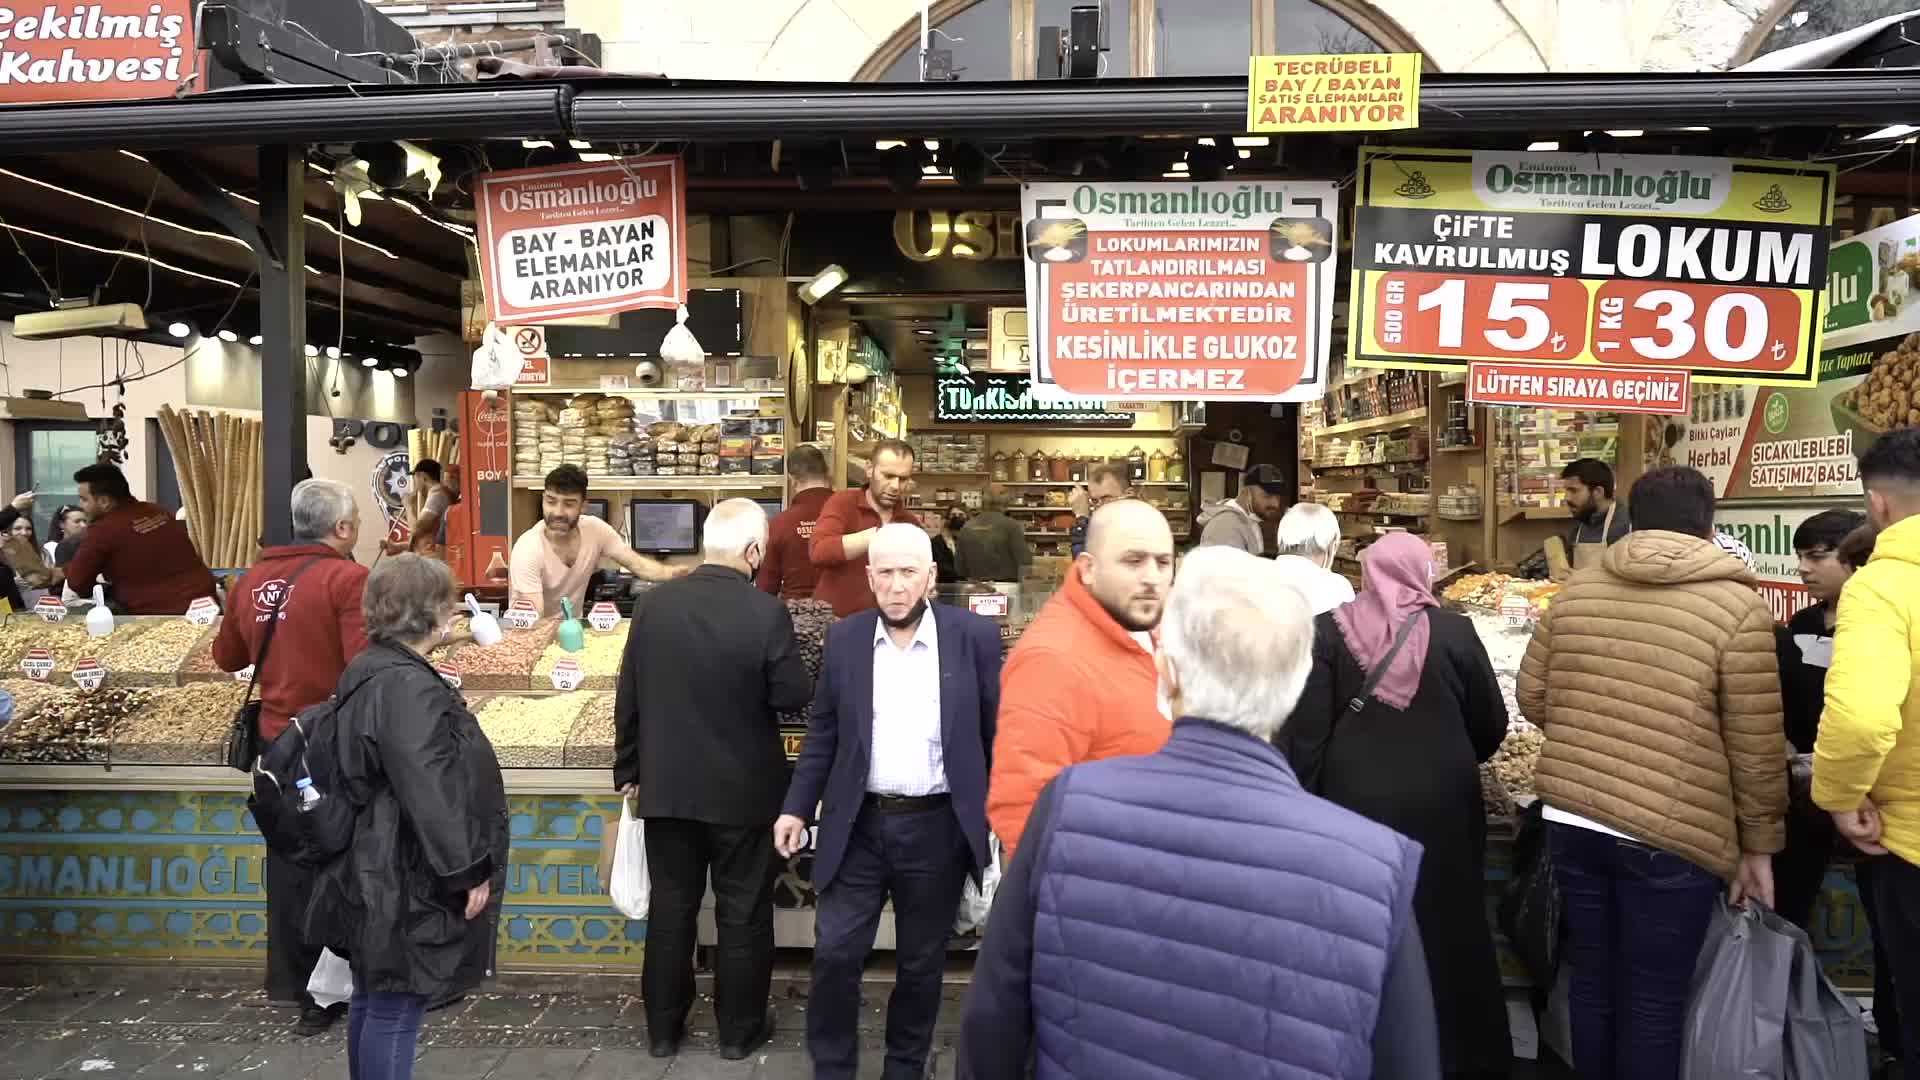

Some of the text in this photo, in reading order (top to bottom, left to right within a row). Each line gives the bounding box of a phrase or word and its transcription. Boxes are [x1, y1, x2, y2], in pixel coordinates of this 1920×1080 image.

[0, 48, 183, 84] Kahvesi
[1274, 56, 1392, 75] TECRÜBELİ
[1265, 77, 1400, 92] BAY / BAYAN
[1306, 92, 1403, 104] ELEMANLARI
[1258, 104, 1405, 124] ARANIYOR
[500, 176, 657, 213] Osmanlıoğlu
[1486, 164, 1712, 204] Osmanlıoğlu
[1072, 185, 1283, 219] Osmanlıoğlu
[511, 231, 557, 255] BAY
[580, 220, 655, 248] BAYAN
[1096, 237, 1260, 252] LOKUMLARIMIZIN
[515, 243, 654, 278] ELEMANLAR
[1091, 259, 1266, 277] TATLANDIRILMASI
[1375, 243, 1570, 276] KAVRULMUŞ
[1581, 223, 1813, 285] LOKUM
[530, 268, 643, 300] ARANIYOR
[1062, 301, 1292, 323] ÜRETİLMEKTEDİR
[1384, 280, 1405, 344] 500 GR
[1417, 279, 1551, 354] 15
[1599, 297, 1623, 329] KG
[1629, 289, 1769, 362] 30
[1056, 329, 1197, 360] KESİNLİKLE
[1203, 335, 1297, 360] GLUKOZ
[1107, 363, 1245, 394] İÇERMEZ
[1477, 370, 1679, 406] LÜTFEN SIRAYA GEÇİNİZ
[1689, 425, 1741, 442] Bitki Çayları
[1752, 431, 1851, 463] SICAK LEBLEBİ
[1688, 446, 1731, 468] Herbal
[1751, 465, 1815, 488] SATIŞIMIZ
[0, 847, 267, 894] MANLIOĞL
